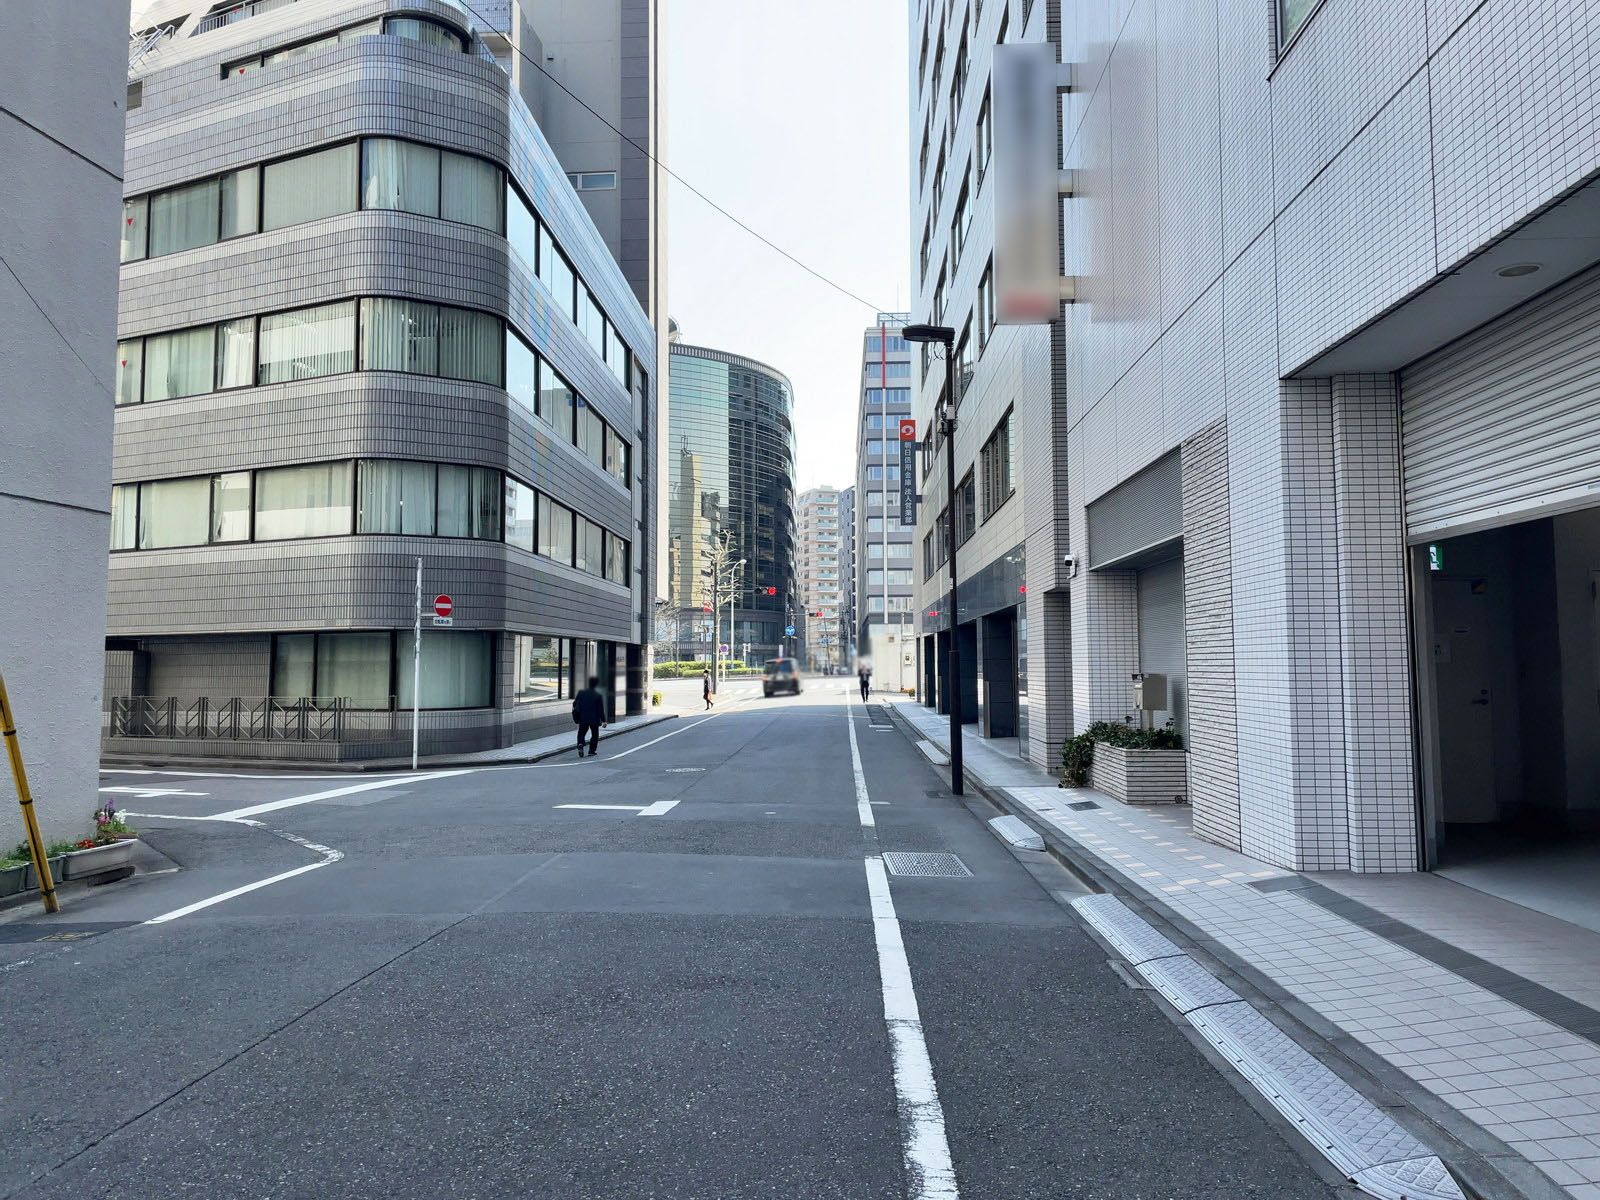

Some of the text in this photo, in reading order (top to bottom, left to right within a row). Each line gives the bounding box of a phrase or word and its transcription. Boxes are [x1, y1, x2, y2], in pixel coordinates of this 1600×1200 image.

[904, 441, 913, 524] 朝日信用金庫 法人営業部
